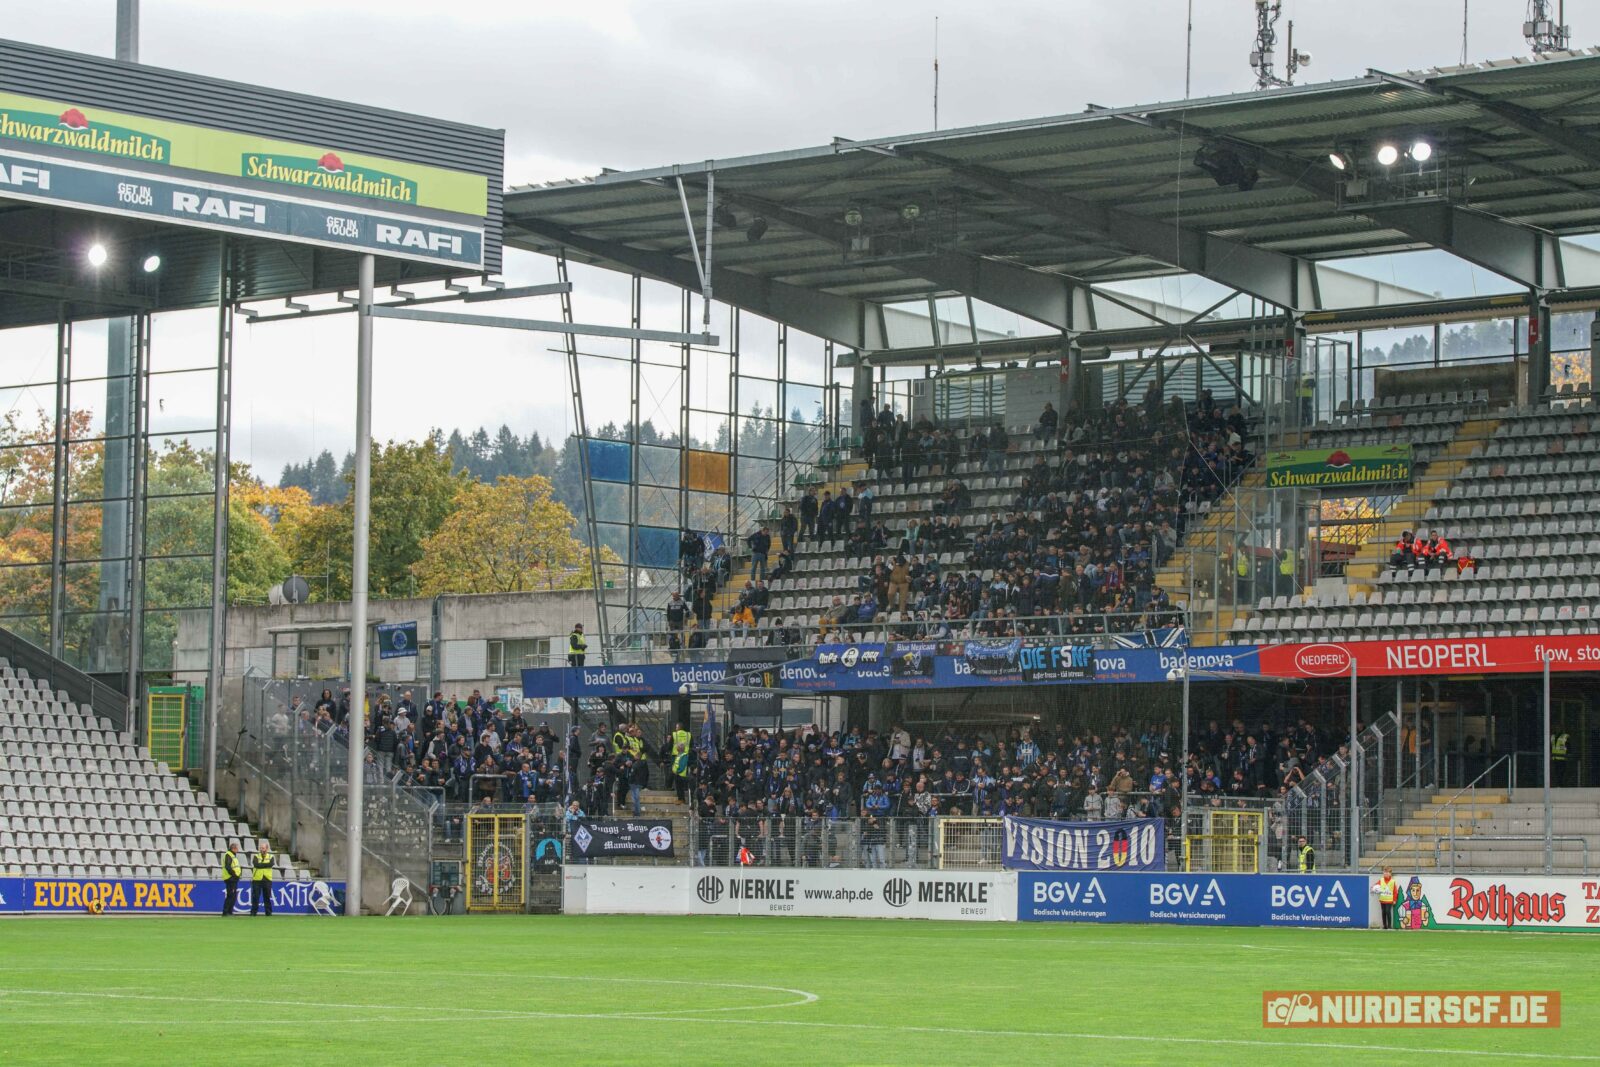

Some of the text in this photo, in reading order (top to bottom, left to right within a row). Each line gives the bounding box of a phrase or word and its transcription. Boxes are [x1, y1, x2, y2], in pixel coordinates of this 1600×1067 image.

[0, 113, 164, 161] hwarzwaldmilch
[247, 155, 412, 202] Schwarzwaldmilch
[117, 183, 151, 198] GET IN
[117, 191, 153, 206] TOUCH
[172, 191, 266, 224] RAFI
[326, 216, 357, 230] GET IN
[326, 225, 359, 238] TOUCH
[376, 225, 463, 255] RAFI
[1270, 463, 1408, 487] Schwarzwaldmilch
[1021, 646, 1047, 670] DIE
[1301, 653, 1343, 666] NEOPERL
[1386, 643, 1497, 669] NEOPERL
[1535, 644, 1600, 664] flow, sto
[584, 669, 644, 686] badenova
[672, 665, 726, 684] badenov
[1004, 816, 1156, 870] VISION 2010
[33, 881, 128, 907] EUROPA
[134, 883, 194, 908] PARK
[729, 879, 794, 900] MERKLE
[804, 887, 873, 903] www.ahp.de
[918, 881, 988, 903] MERKLE
[769, 904, 795, 912] BEWEGT
[961, 907, 988, 915] BEWEGT
[1447, 877, 1567, 928] Rothaus
[1033, 908, 1107, 918] Badische Versicherungen
[1150, 910, 1226, 920] Badische Versicherungen
[1271, 913, 1351, 922] Badische Versicherungen
